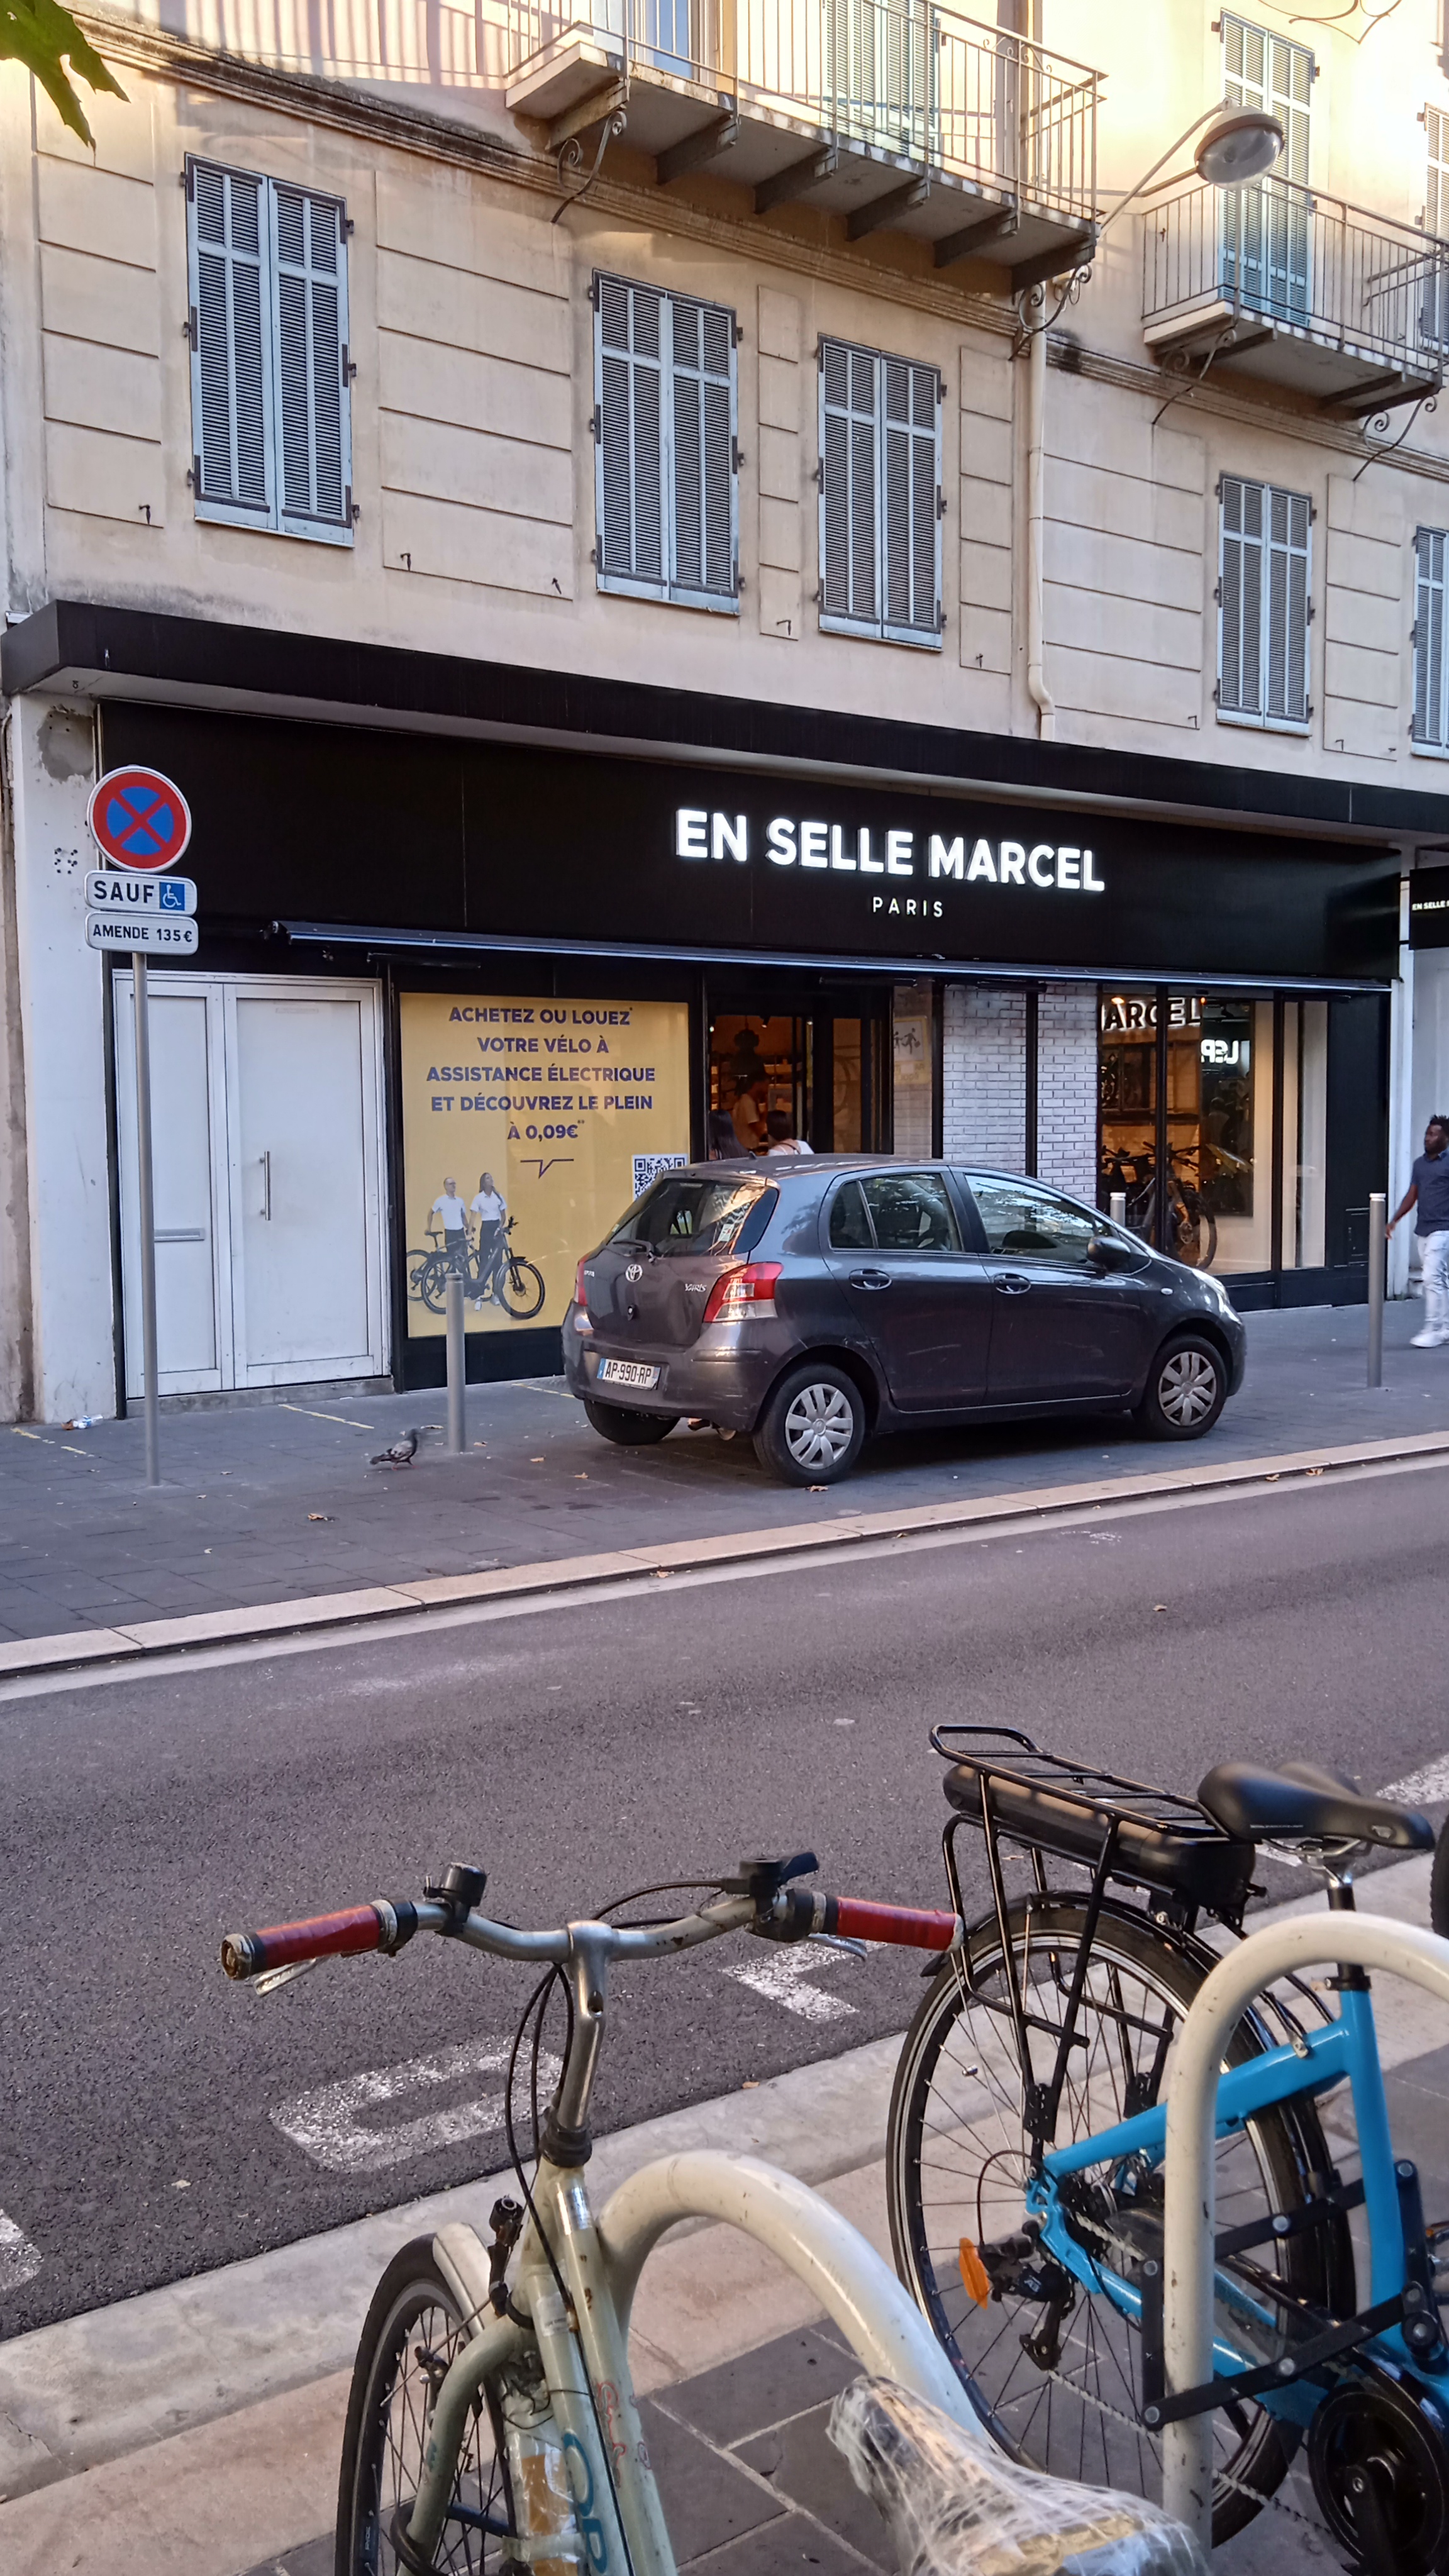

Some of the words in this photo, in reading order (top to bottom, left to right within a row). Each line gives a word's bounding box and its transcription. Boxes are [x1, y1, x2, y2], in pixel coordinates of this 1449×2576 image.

[676, 808, 747, 862] EN
[765, 818, 914, 875] SELLE
[928, 835, 1106, 892] MARCEL
[94, 880, 154, 903] SAUF
[872, 897, 944, 918] PARIS
[1423, 901, 1445, 909] SELLE
[93, 923, 149, 940] AMENDE
[157, 928, 192, 943] 135€
[449, 1006, 534, 1023] ACHETEZ
[540, 1009, 567, 1024] OU
[1101, 997, 1201, 1031] ARCEL
[477, 1037, 538, 1053] VOTRE
[543, 1035, 592, 1053] VÉLO
[596, 1035, 609, 1053] À
[426, 1067, 541, 1082] ASSISTANCE
[547, 1063, 655, 1082] ÉLECTRIQUE
[431, 1096, 454, 1111] ET
[460, 1092, 573, 1111] DÉCOUVREZ
[579, 1096, 598, 1110] LE
[604, 1096, 652, 1110] PLEIN
[508, 1121, 521, 1140] À
